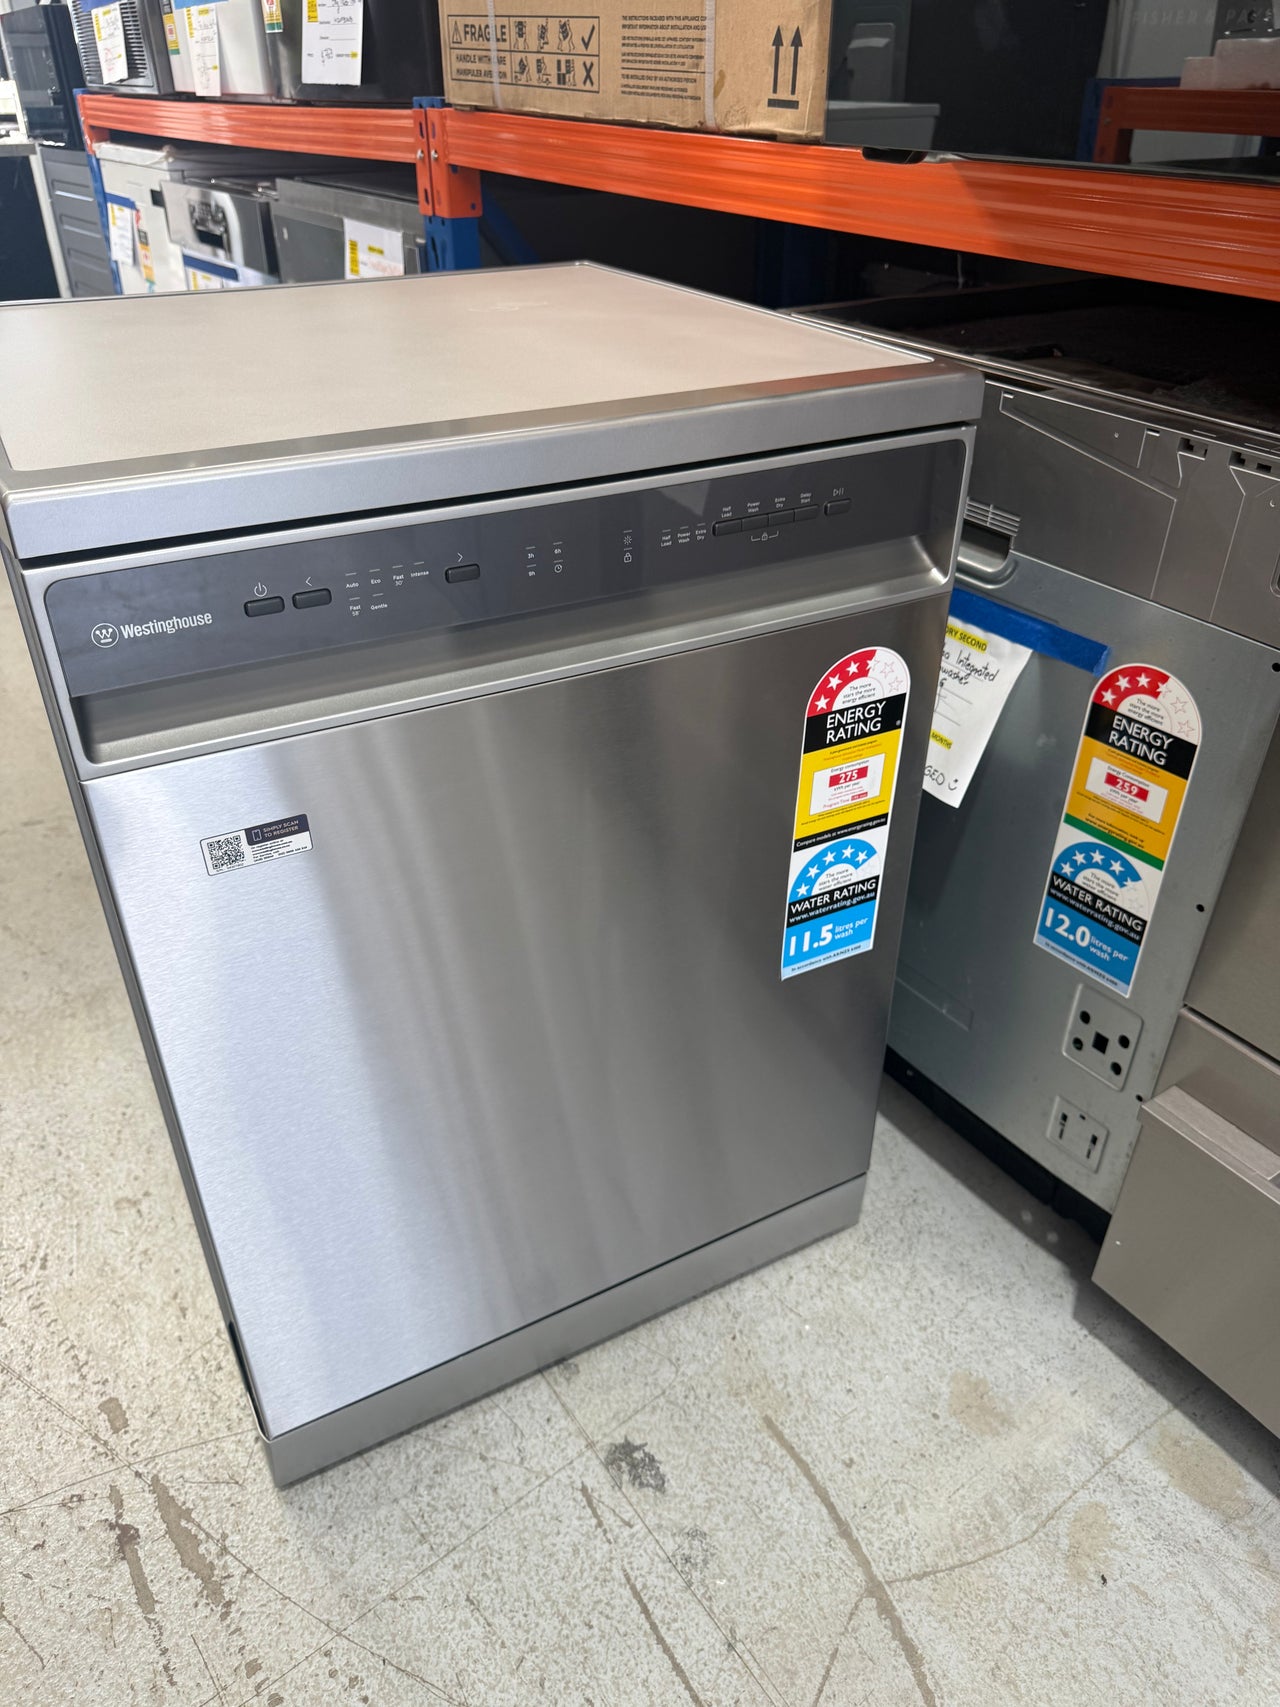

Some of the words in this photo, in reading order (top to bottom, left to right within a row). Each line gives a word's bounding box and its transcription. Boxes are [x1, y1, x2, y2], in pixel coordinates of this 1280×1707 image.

[464, 24, 507, 42] FRAGLE
[120, 613, 213, 639] Westinghouse
[959, 632, 987, 652] SECOND
[858, 693, 876, 701] efficient
[1137, 698, 1146, 706] The
[1147, 703, 1160, 712] more
[826, 700, 887, 729] ENERGY
[1128, 708, 1143, 718] energy
[1144, 714, 1164, 726] efficient
[1129, 702, 1141, 710] stars
[1150, 712, 1164, 720] more
[826, 717, 882, 744] RATING
[1112, 715, 1174, 750] ENERGY
[1108, 730, 1167, 766] RATING
[839, 770, 858, 784] 275
[1107, 765, 1121, 775] Energy
[1122, 771, 1150, 788] Consumption
[1116, 778, 1139, 796] 259
[263, 824, 282, 832] SIMPLY
[283, 820, 299, 828] SCAN
[273, 825, 299, 836] REGISTER
[796, 837, 816, 848] Compare
[817, 833, 832, 842] models
[1091, 872, 1099, 880] The
[1100, 878, 1115, 889] more
[1095, 882, 1104, 890] the
[1104, 886, 1119, 896] more
[790, 894, 830, 914] WATER
[833, 879, 876, 901] RATING
[1053, 875, 1092, 905] WATER
[1095, 899, 1143, 932] RATING
[789, 891, 875, 924] www.waterrating.gov.au
[1050, 888, 1141, 941] www.waterrating.gov.au
[789, 923, 834, 957] 11.5
[834, 922, 854, 933] litres
[855, 918, 869, 928] per
[834, 929, 854, 940] wash
[1045, 907, 1091, 947] 12.0
[1090, 936, 1112, 953] litres
[1113, 949, 1129, 961] per
[1089, 945, 1110, 961] wash
